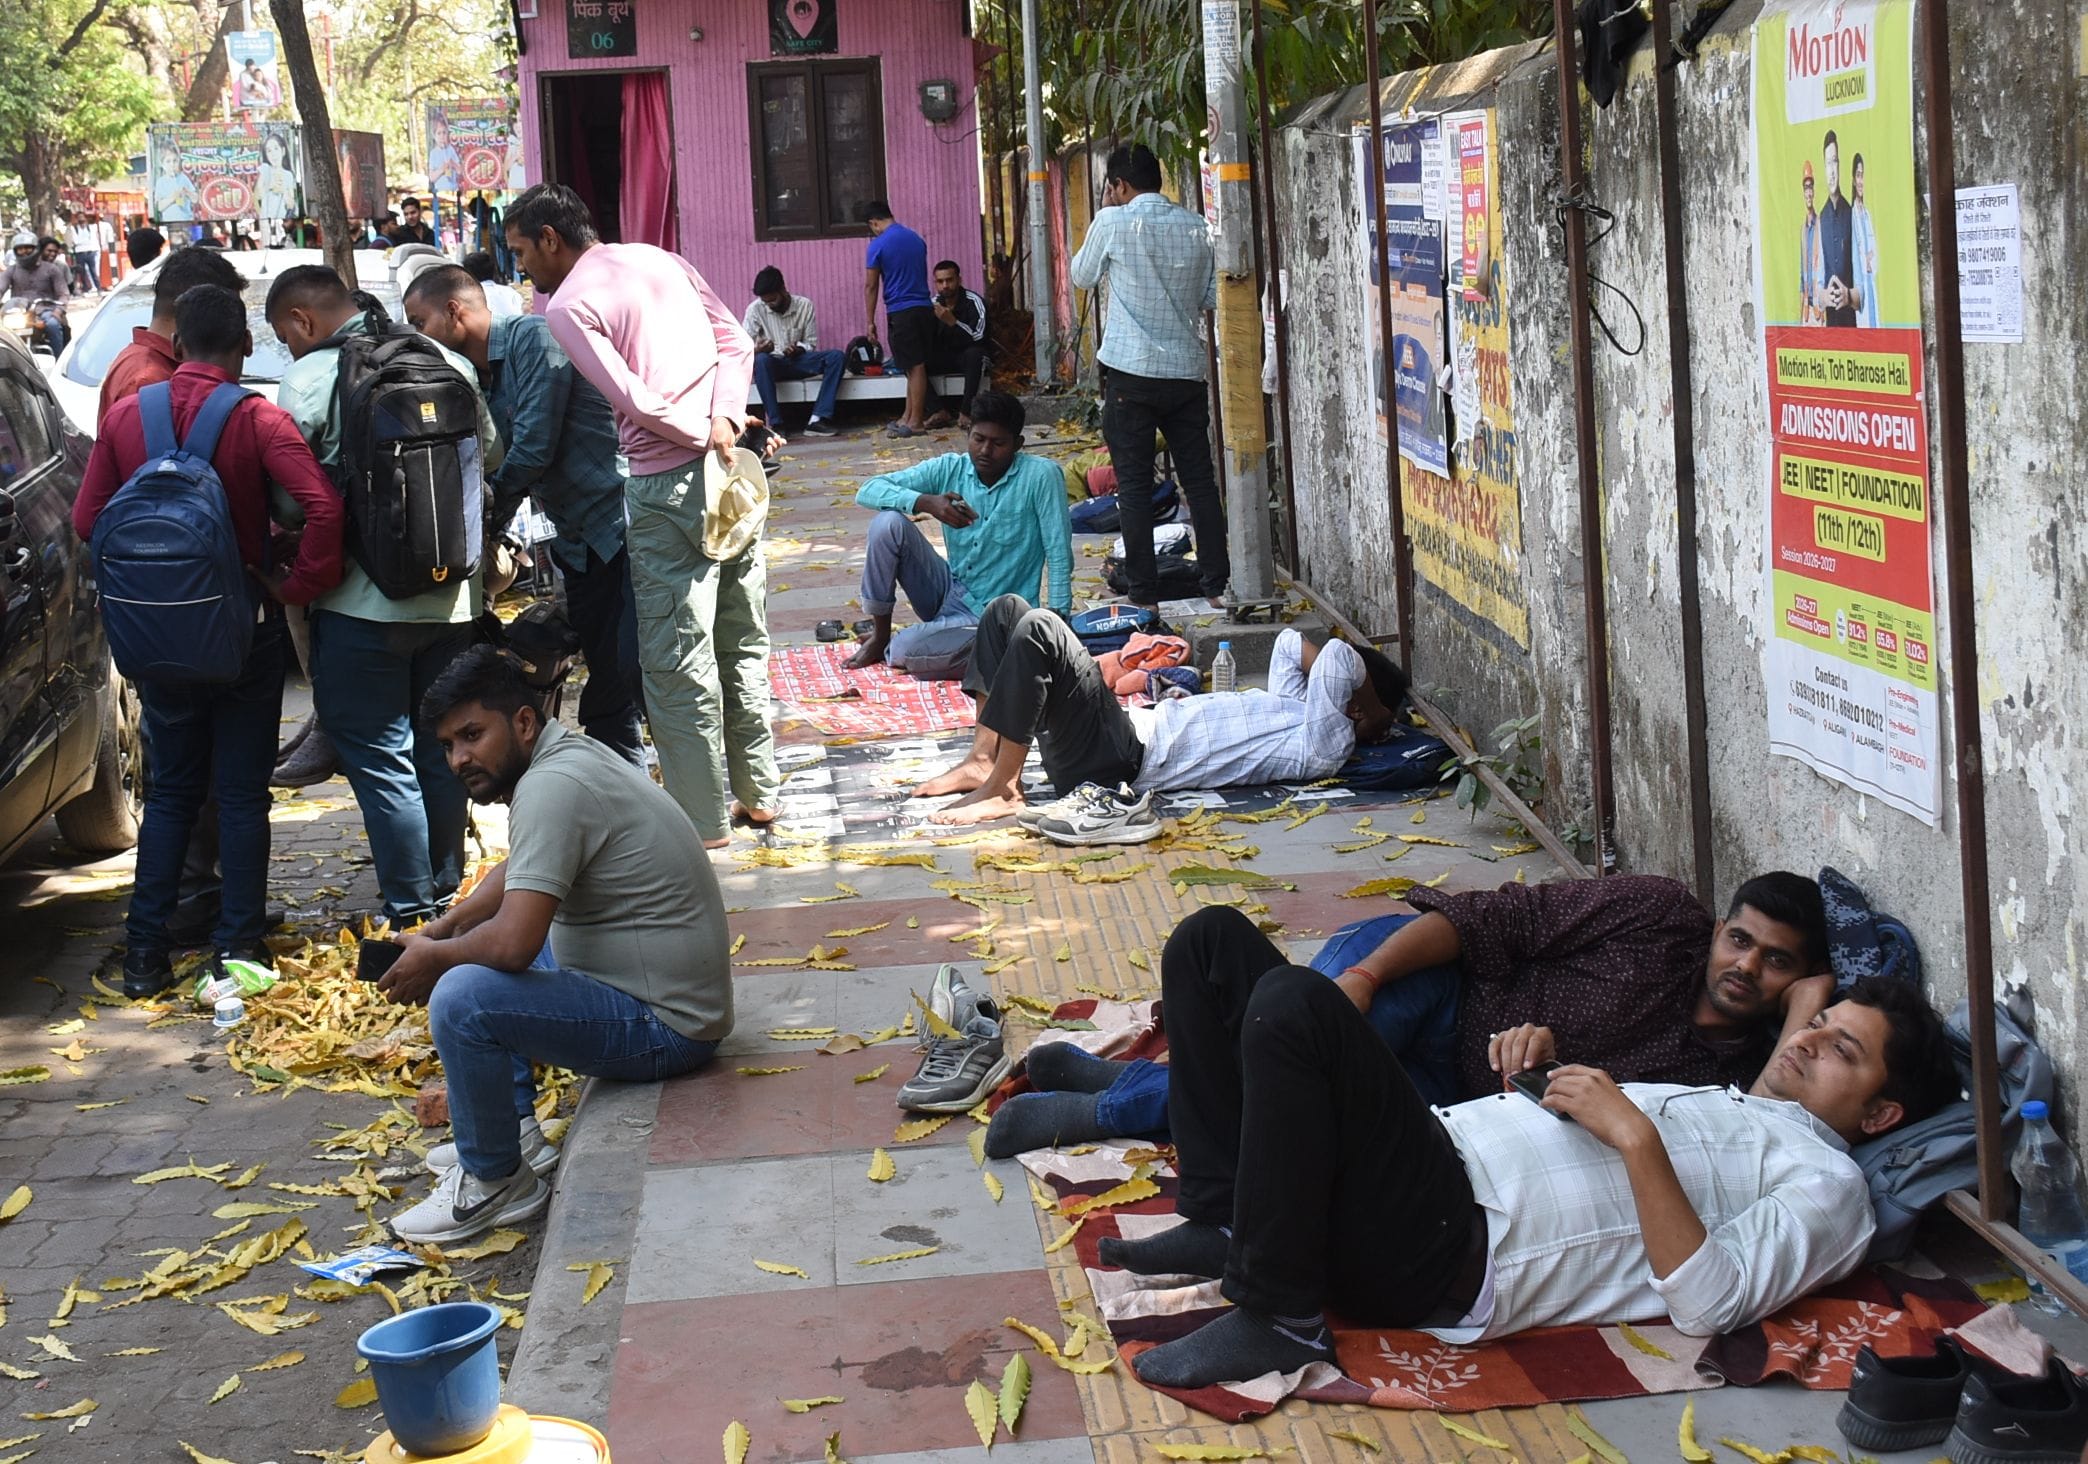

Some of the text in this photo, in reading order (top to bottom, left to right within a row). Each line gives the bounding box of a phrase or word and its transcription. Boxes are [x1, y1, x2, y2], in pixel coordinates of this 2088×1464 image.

[607, 1, 629, 24] बूथ
[591, 31, 614, 50] 06
[806, 39, 822, 47] CITY
[1789, 22, 1866, 81] MOTION
[1825, 74, 1865, 102] LUCKNOW
[1976, 193, 2009, 208] जंक्शन
[1968, 246, 2006, 263] 9807419006
[1779, 355, 1908, 386] Motion Hai, Toh Bharosa Hai.
[1780, 403, 1916, 452] ADMISSIONS OPEN
[1783, 461, 1922, 511] JEE NEET FOUNDATION
[1817, 511, 1844, 543] (11th
[1781, 545, 1836, 573] Session 2026-2027
[1813, 619, 1830, 636] Open
[1815, 666, 1848, 691] Contact us
[1889, 746, 1926, 770] FOUNDATION
